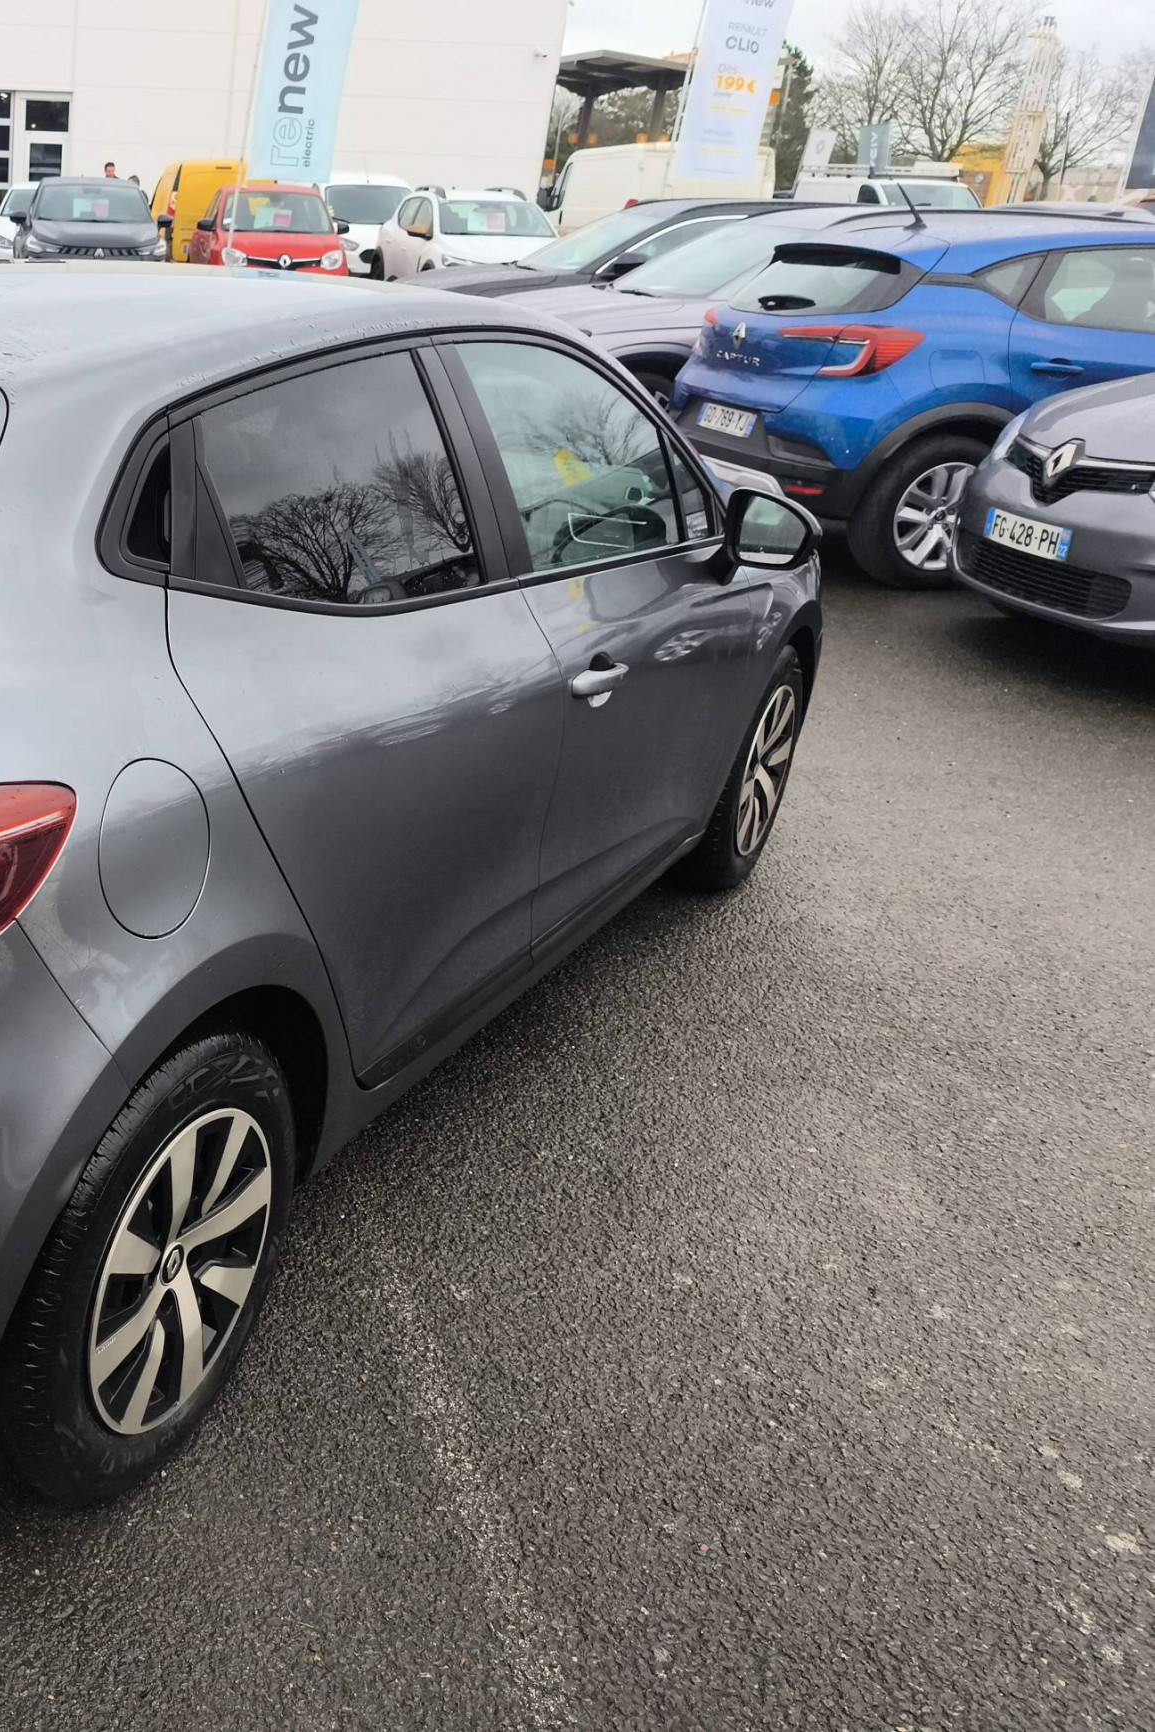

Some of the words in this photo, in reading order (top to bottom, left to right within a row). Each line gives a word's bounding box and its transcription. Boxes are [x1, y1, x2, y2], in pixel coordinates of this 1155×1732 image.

[728, 21, 768, 37] RENAULT
[725, 36, 759, 54] CLIO
[270, 4, 319, 167] renew
[303, 118, 315, 168] electric
[716, 350, 761, 367] CAPTUR
[992, 514, 1060, 555] FG-428-PH
